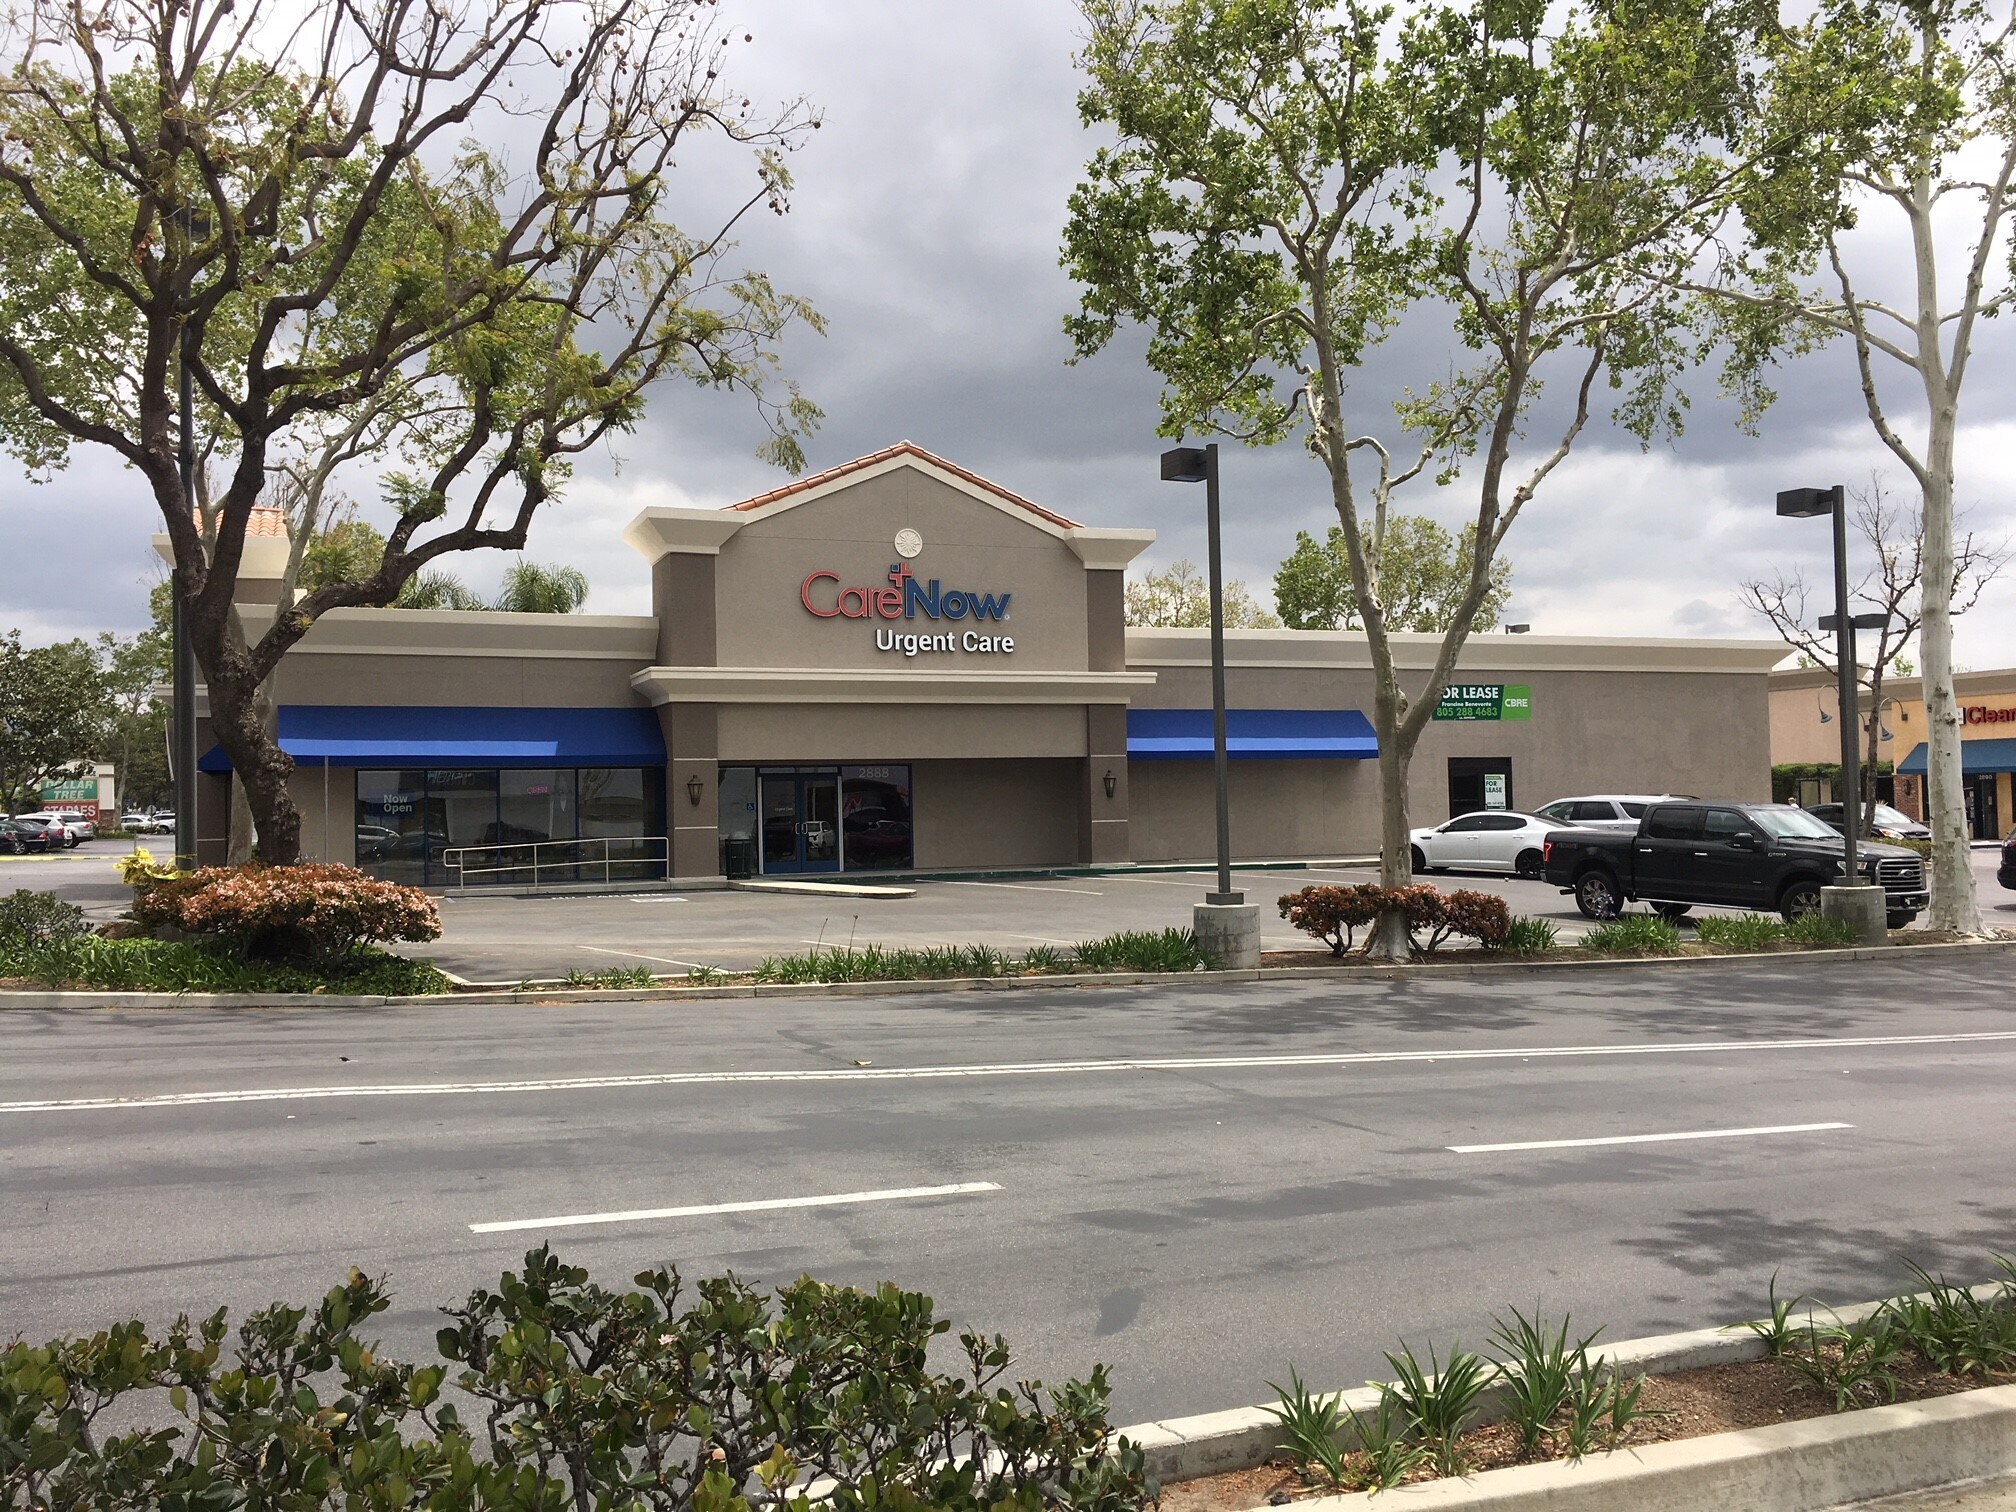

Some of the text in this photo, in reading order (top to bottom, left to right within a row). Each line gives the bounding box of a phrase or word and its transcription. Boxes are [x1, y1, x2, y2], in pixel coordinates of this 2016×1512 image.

[876, 628, 1015, 656] Urgent Care
[1463, 687, 1498, 698] LEASE
[1504, 699, 1528, 707] CBRE
[1437, 707, 1497, 716] 805 288 4683
[858, 767, 889, 778] 2888
[45, 780, 93, 789] DOLLAR
[54, 790, 84, 799] TREE
[383, 794, 408, 804] Now
[383, 803, 412, 814] Open
